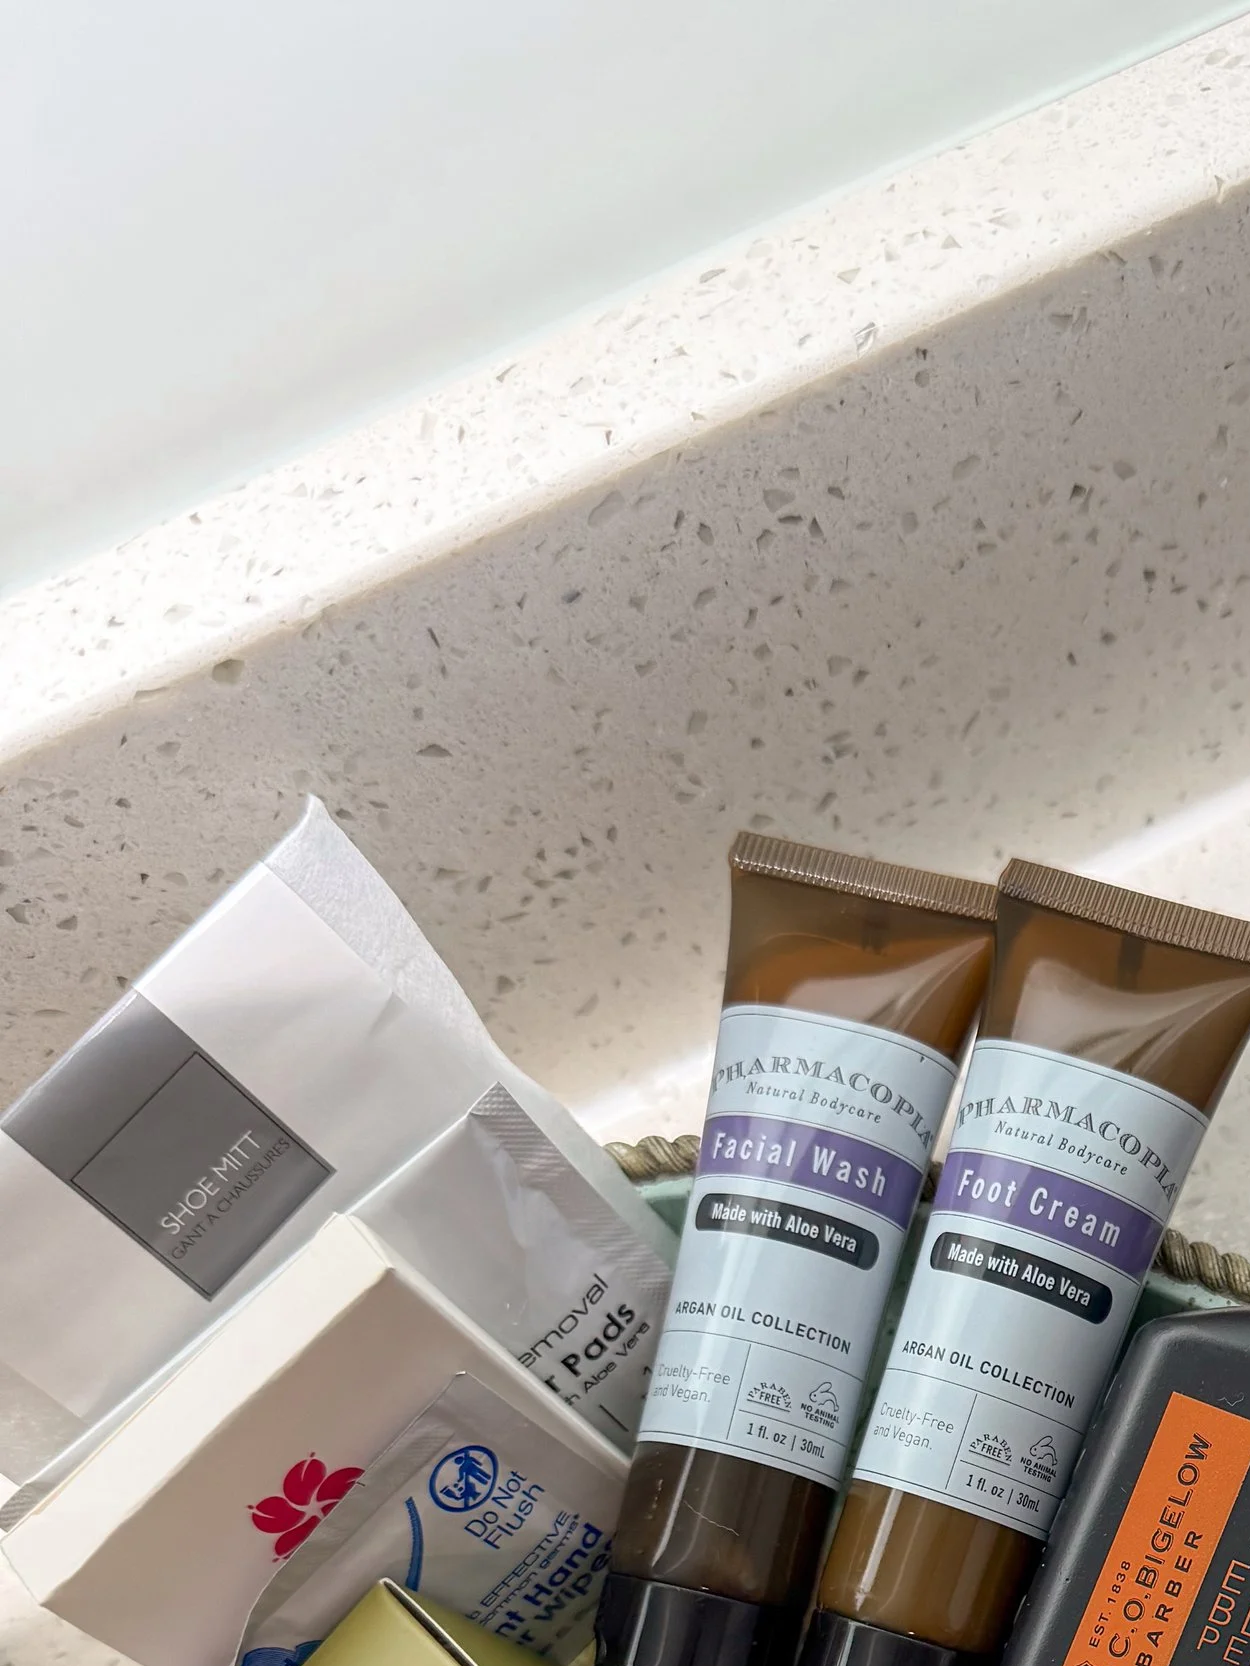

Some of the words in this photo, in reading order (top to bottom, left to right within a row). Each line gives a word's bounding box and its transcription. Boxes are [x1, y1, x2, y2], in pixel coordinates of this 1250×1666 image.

[711, 1056, 933, 1150] PHARMACOPIA
[746, 1081, 804, 1101] Natural
[809, 1092, 882, 1124] Bodycare
[713, 1132, 797, 1167] Facial
[813, 1145, 886, 1197] Wash
[958, 1096, 1177, 1202] PHARMACOPIA
[994, 1120, 1054, 1146] Natural
[1058, 1137, 1128, 1175] Bodycare
[161, 1177, 220, 1234] SHOE
[211, 1130, 260, 1181] MITT
[172, 1223, 206, 1259] GANT
[217, 1138, 290, 1212] CHAUSSURES
[957, 1169, 1017, 1207] Foot
[1029, 1187, 1121, 1247] Cream
[712, 1203, 746, 1222] Made
[751, 1209, 782, 1229] with
[785, 1215, 819, 1239] Aloe
[825, 1224, 857, 1253] Vera
[948, 1242, 984, 1266] Made
[987, 1255, 1019, 1277] with
[1021, 1263, 1055, 1291] Aloe
[1059, 1276, 1091, 1306] Vera
[518, 1273, 608, 1368] emoval
[561, 1304, 635, 1377] Pads
[675, 1301, 716, 1316] ARGAN
[721, 1305, 746, 1322] OIL
[752, 1312, 851, 1354] COLLECTION
[584, 1361, 617, 1393] Aloe
[615, 1322, 650, 1357] Vera
[658, 1363, 731, 1385] Cruelty-Free
[902, 1340, 946, 1361] ARGAN
[950, 1351, 974, 1370] OIL
[980, 1361, 1075, 1408] COLLECTION
[653, 1384, 669, 1397] and
[671, 1384, 711, 1403] Vegan.
[748, 1382, 792, 1409] PARABEN
[759, 1391, 781, 1405] FREE
[801, 1403, 812, 1412] NO
[814, 1408, 839, 1424] ANIMAL
[805, 1412, 834, 1429] TESTING
[880, 1402, 954, 1434] Cruelty-Free
[747, 1423, 754, 1435] 1
[758, 1425, 769, 1440] fl.
[773, 1433, 787, 1445] oz
[800, 1438, 825, 1459] 30mL
[874, 1423, 890, 1438] and
[893, 1426, 932, 1450] Vegan.
[970, 1434, 1012, 1462] PARABEN
[981, 1443, 1003, 1458] FREE
[966, 1474, 973, 1487] 1
[976, 1477, 986, 1492] fl.
[991, 1486, 1005, 1498] oz
[1016, 1492, 1040, 1512] 30mL
[1020, 1457, 1032, 1466] NO
[1033, 1463, 1057, 1478] ANIMAL
[1024, 1466, 1051, 1482] TESTING
[464, 1511, 498, 1538] Do
[491, 1470, 527, 1509] Not
[483, 1484, 545, 1549] Flush
[481, 1511, 571, 1607] EFFECTIVE
[524, 1523, 602, 1606] Hand
[1089, 1609, 1112, 1648] EST.
[1108, 1560, 1131, 1604] 1838
